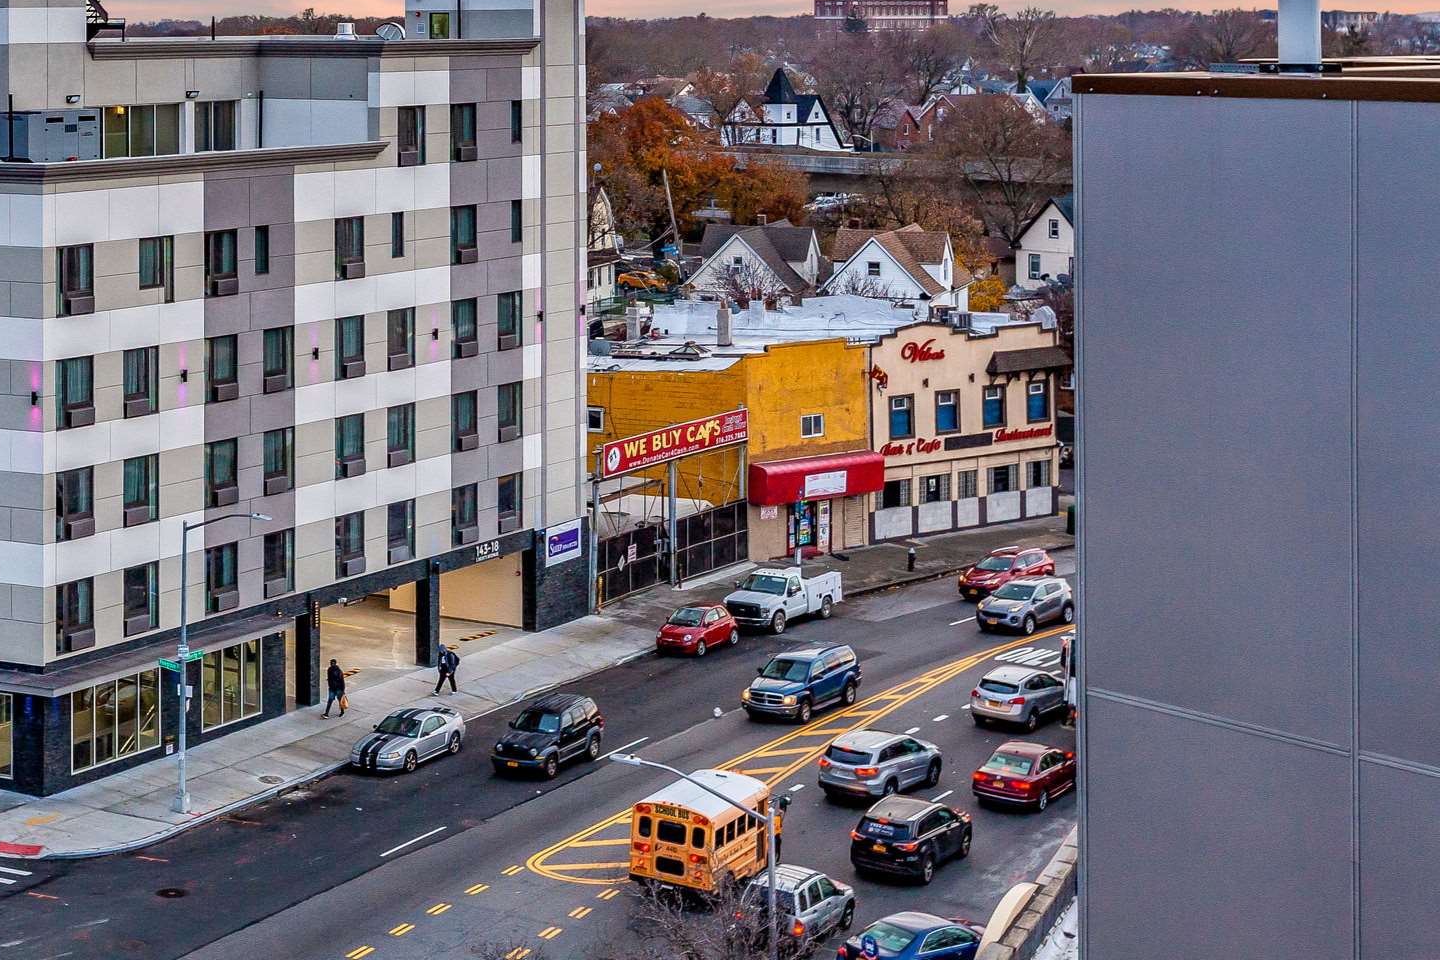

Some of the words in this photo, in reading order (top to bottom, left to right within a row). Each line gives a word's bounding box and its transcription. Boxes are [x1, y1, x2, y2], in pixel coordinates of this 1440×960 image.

[624, 438, 647, 459] WE
[652, 429, 682, 452] BUY
[475, 541, 499, 557] 143-18
[655, 804, 677, 817] SCHOOL
[677, 808, 689, 820] BUS
